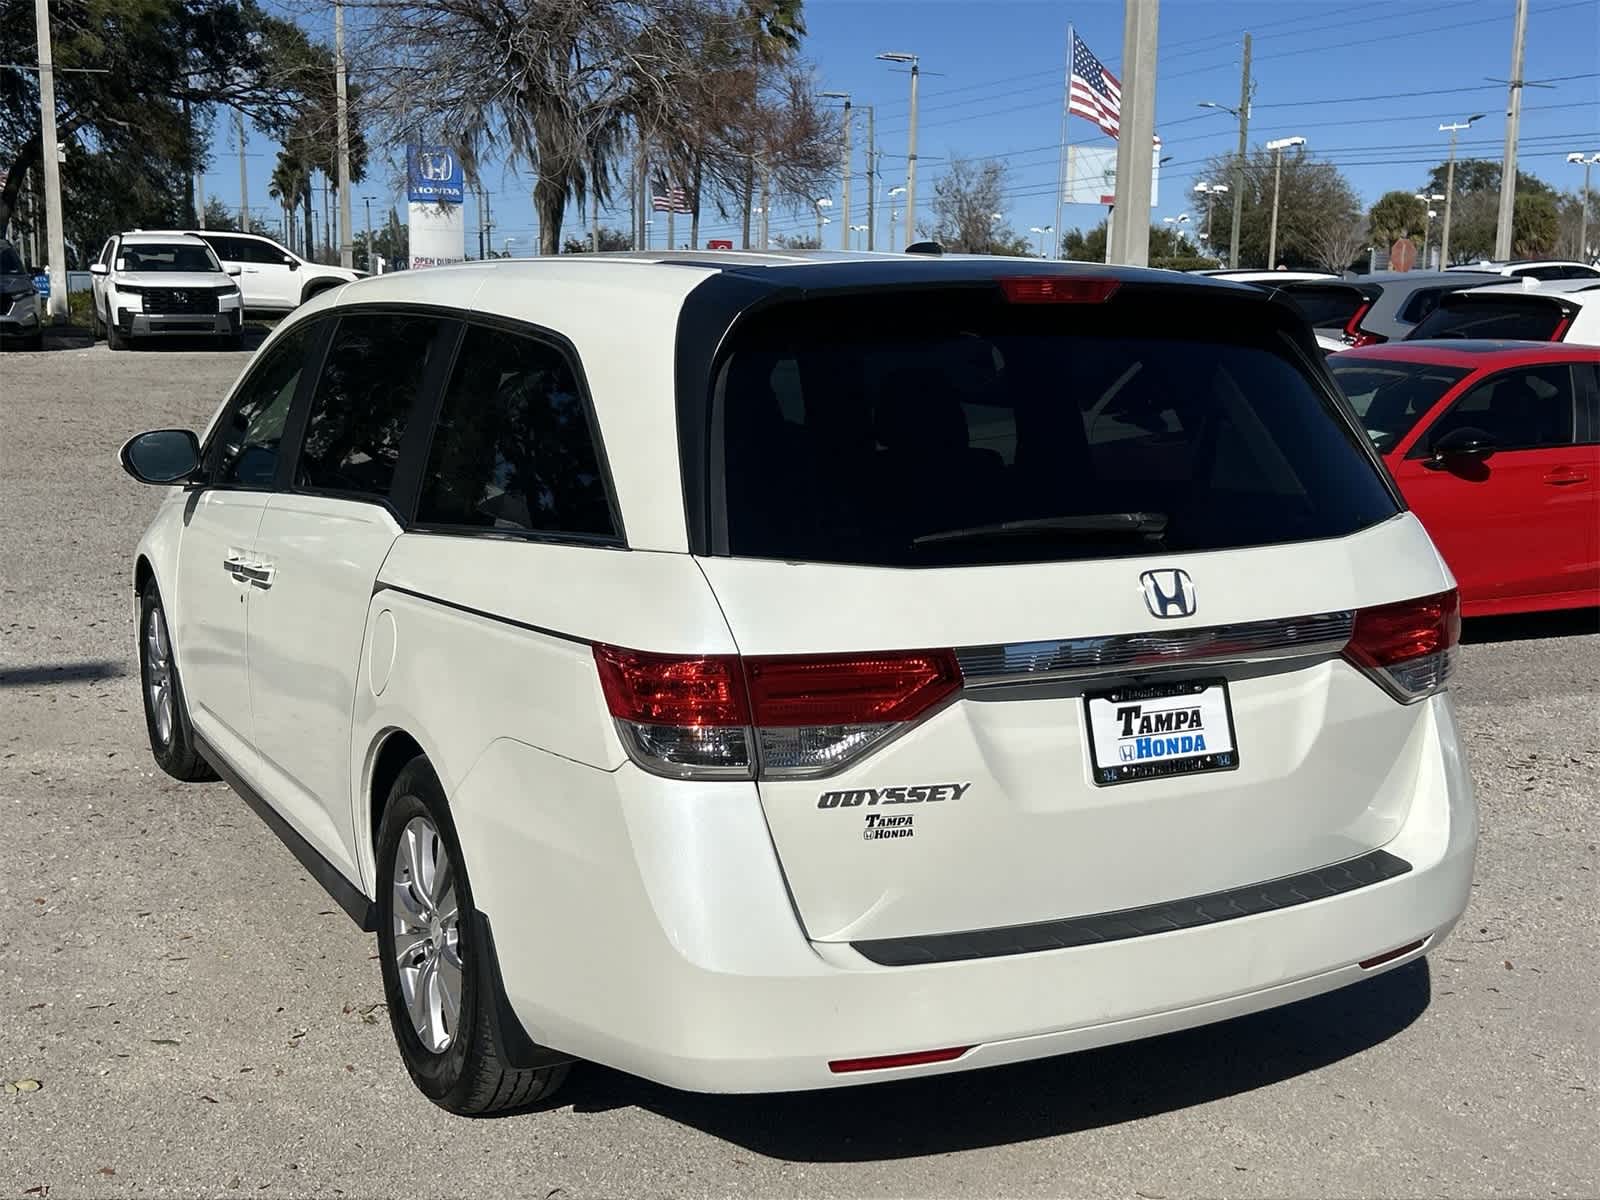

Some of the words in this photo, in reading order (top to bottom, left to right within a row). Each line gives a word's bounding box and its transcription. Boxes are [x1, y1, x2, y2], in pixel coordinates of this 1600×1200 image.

[415, 257, 435, 265] OPEN
[1116, 705, 1202, 736] TAMPA
[1136, 734, 1206, 759] HONDA
[817, 783, 971, 809] ODYSSEY
[865, 814, 913, 828] TAMPA
[874, 828, 914, 840] HONDA
